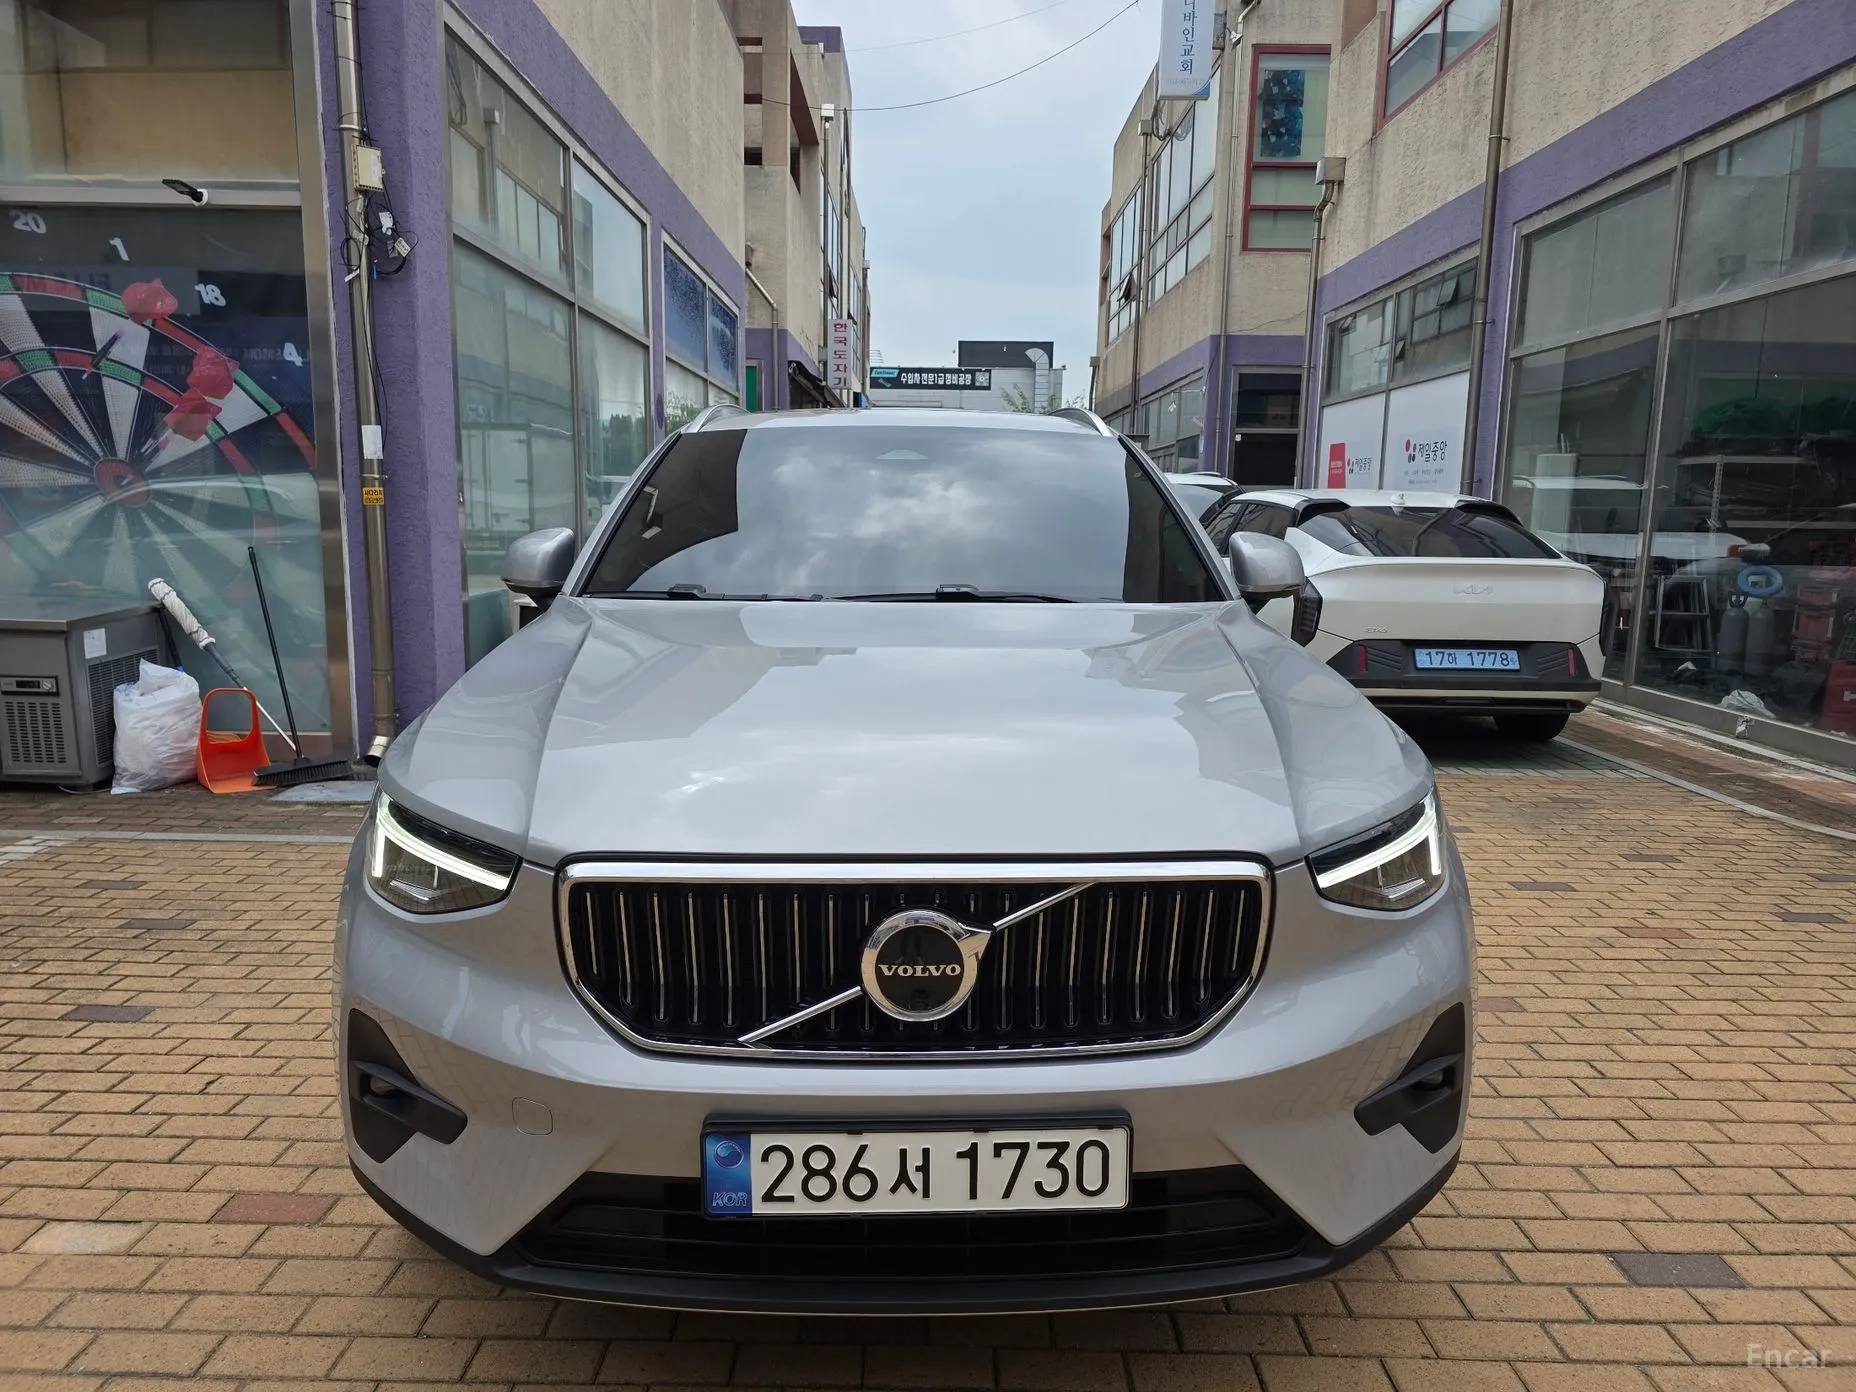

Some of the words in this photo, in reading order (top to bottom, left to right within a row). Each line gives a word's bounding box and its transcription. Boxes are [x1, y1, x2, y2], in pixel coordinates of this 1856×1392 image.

[9, 210, 47, 234] 20
[109, 236, 130, 261] 1
[194, 282, 227, 307] 18
[282, 341, 303, 367] 4
[832, 322, 848, 387] 한국도자기
[900, 372, 921, 385] 수입차
[945, 373, 973, 386] 정비공장
[1417, 440, 1448, 463] 제일중앙
[1466, 651, 1510, 667] 1778
[878, 963, 962, 978] VOLVO
[760, 1143, 932, 1203] 286서
[955, 1139, 1111, 1201] 1730
[712, 1190, 749, 1208] KOR
